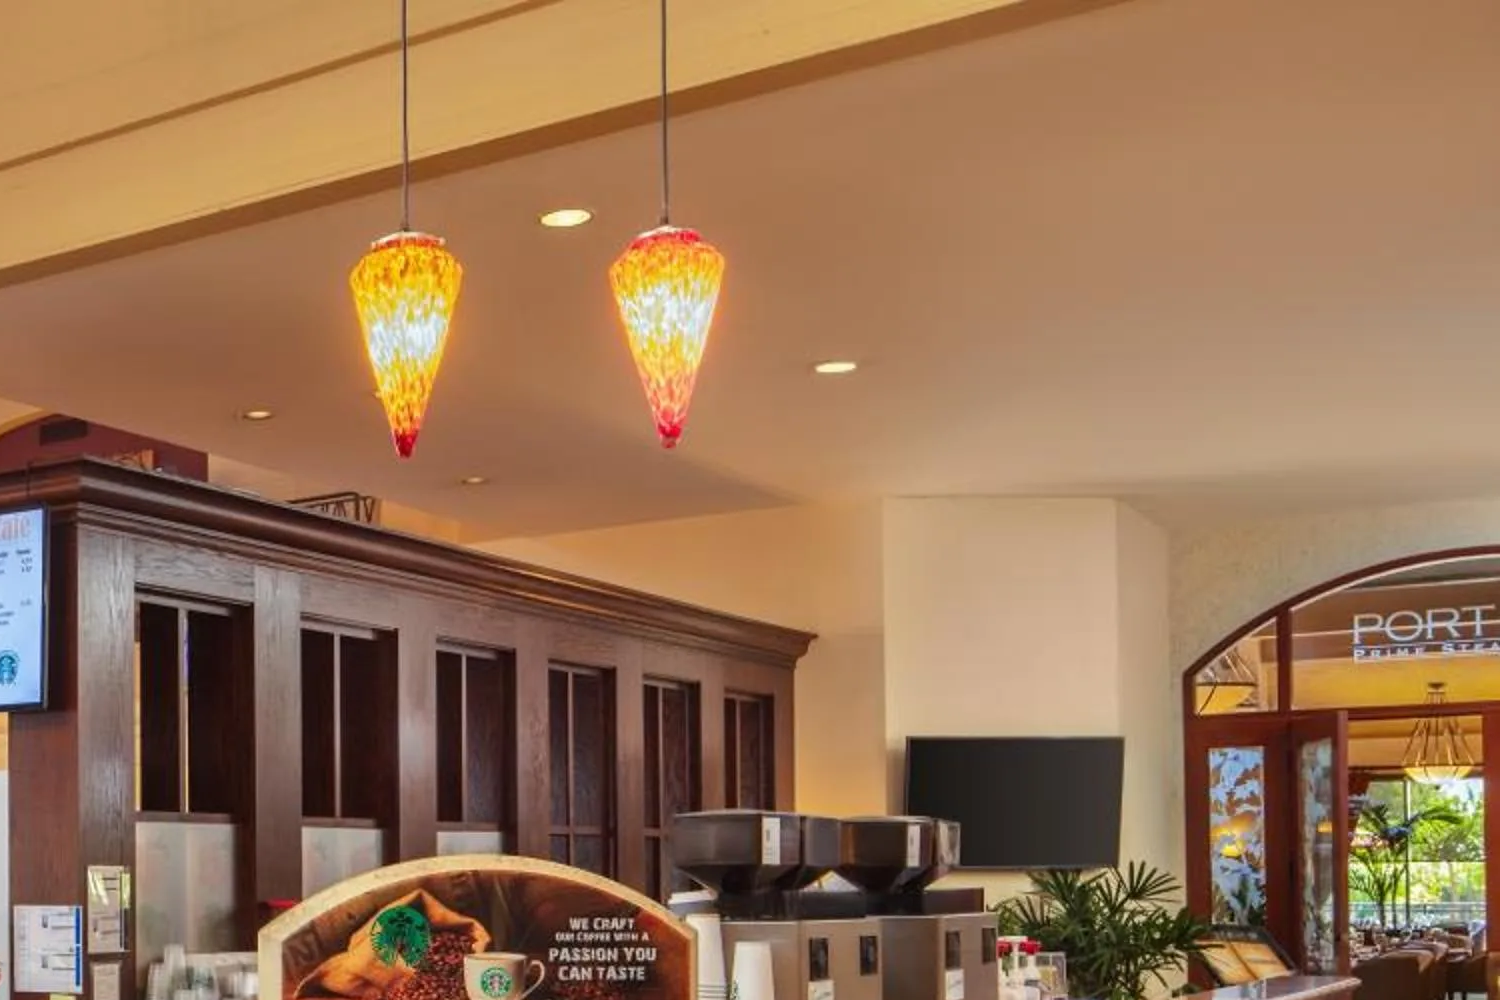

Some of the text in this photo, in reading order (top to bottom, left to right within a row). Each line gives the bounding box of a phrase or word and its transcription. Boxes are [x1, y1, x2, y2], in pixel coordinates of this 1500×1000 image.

[1352, 604, 1497, 645] PORT
[569, 917, 635, 931] WE CRAFT
[641, 932, 650, 941] A
[548, 947, 658, 962] PASSION YOU
[558, 966, 645, 981] CAN TASTE
